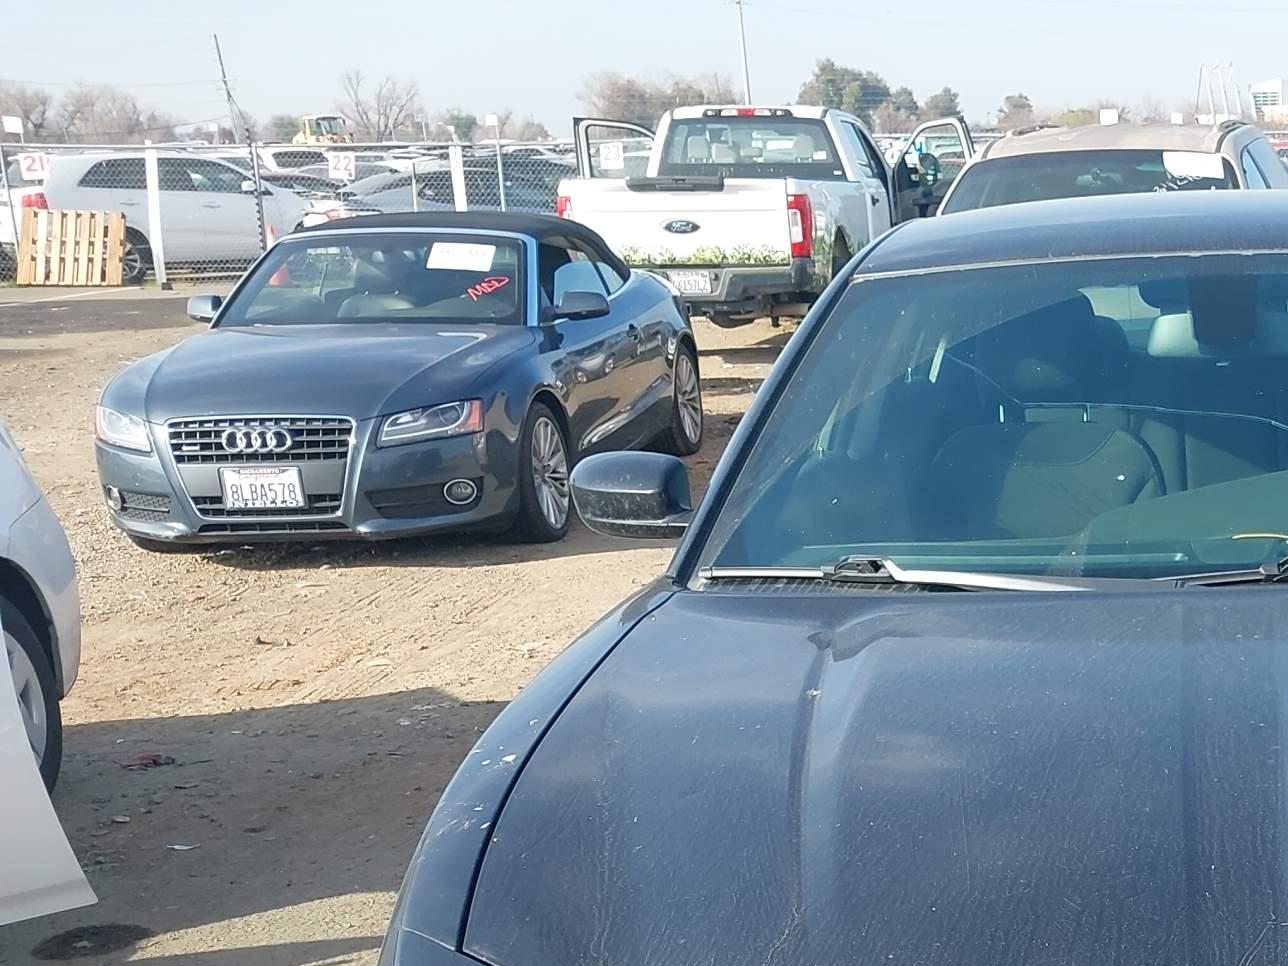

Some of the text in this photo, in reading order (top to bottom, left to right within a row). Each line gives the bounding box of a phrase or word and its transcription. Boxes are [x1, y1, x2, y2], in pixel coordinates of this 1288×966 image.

[603, 144, 621, 161] 23
[24, 155, 45, 172] 21
[333, 155, 352, 171] 22
[230, 483, 297, 502] 8LBA578
